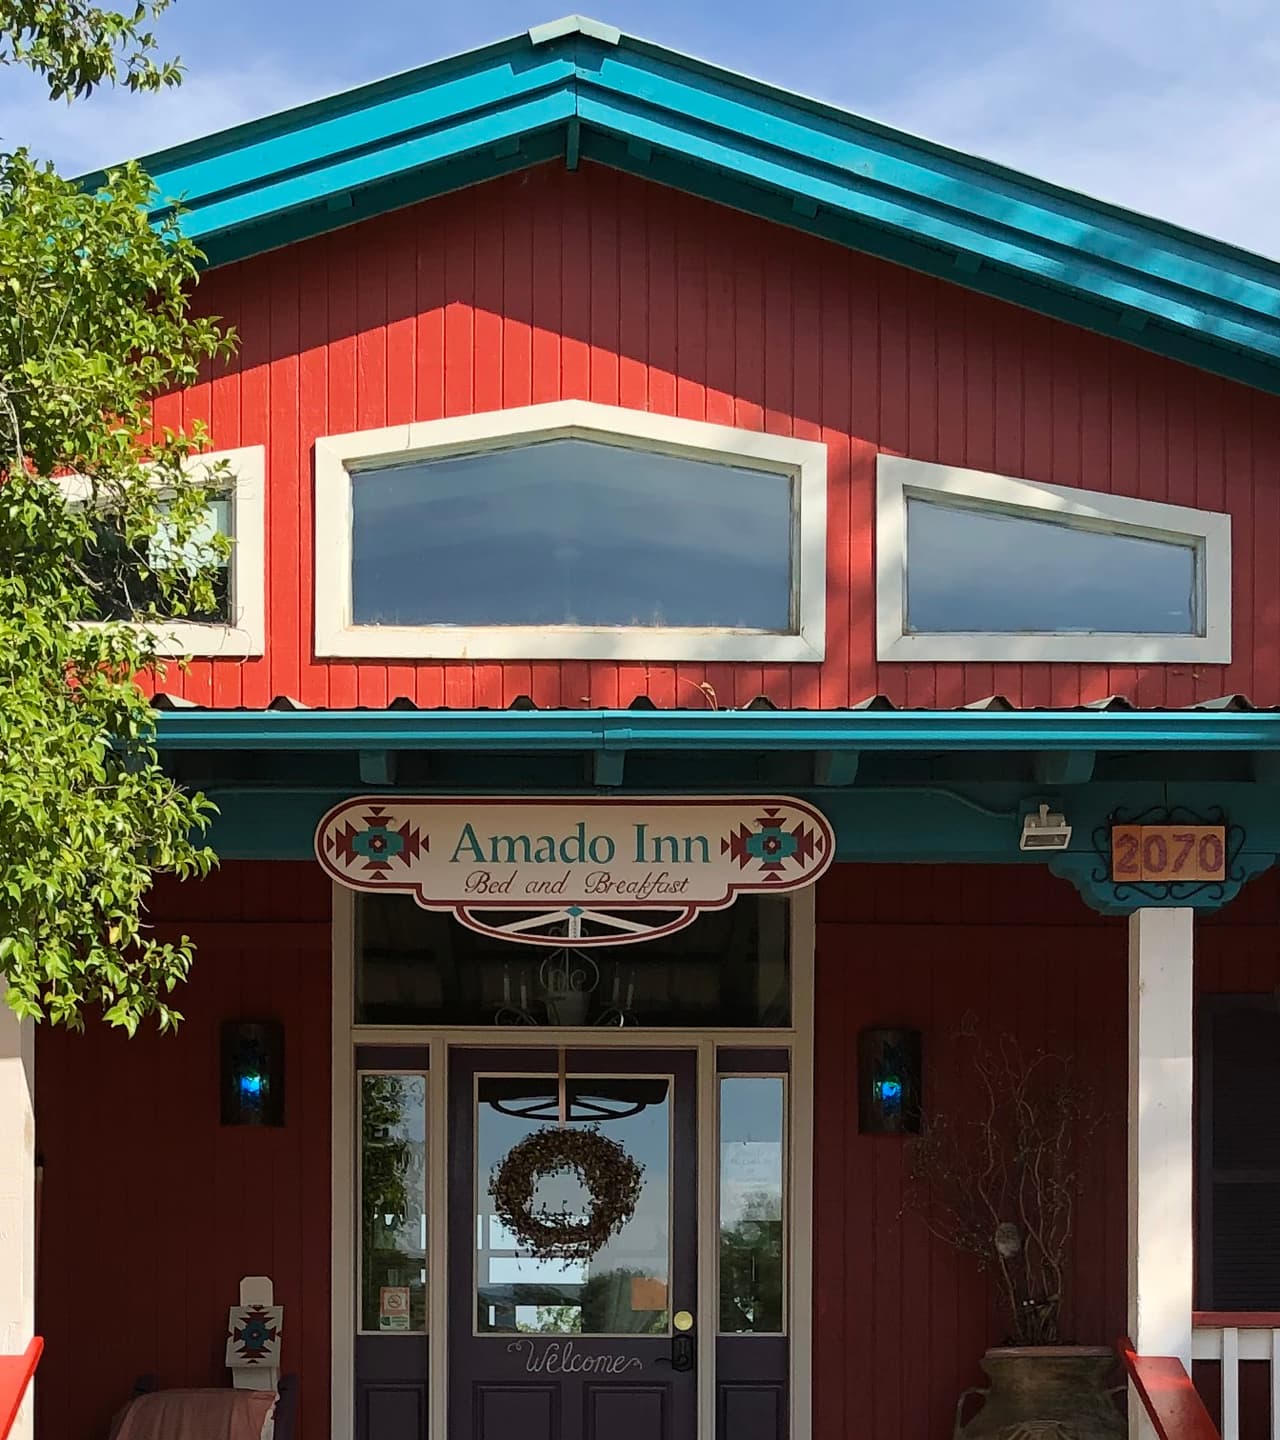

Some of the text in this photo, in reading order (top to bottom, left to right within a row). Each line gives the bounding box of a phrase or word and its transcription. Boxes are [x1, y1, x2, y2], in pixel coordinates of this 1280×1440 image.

[448, 821, 712, 865] Amado Inn
[1115, 833, 1224, 873] 2070
[464, 869, 690, 900] Bed and Breakfast
[507, 1339, 643, 1374] Welcome
